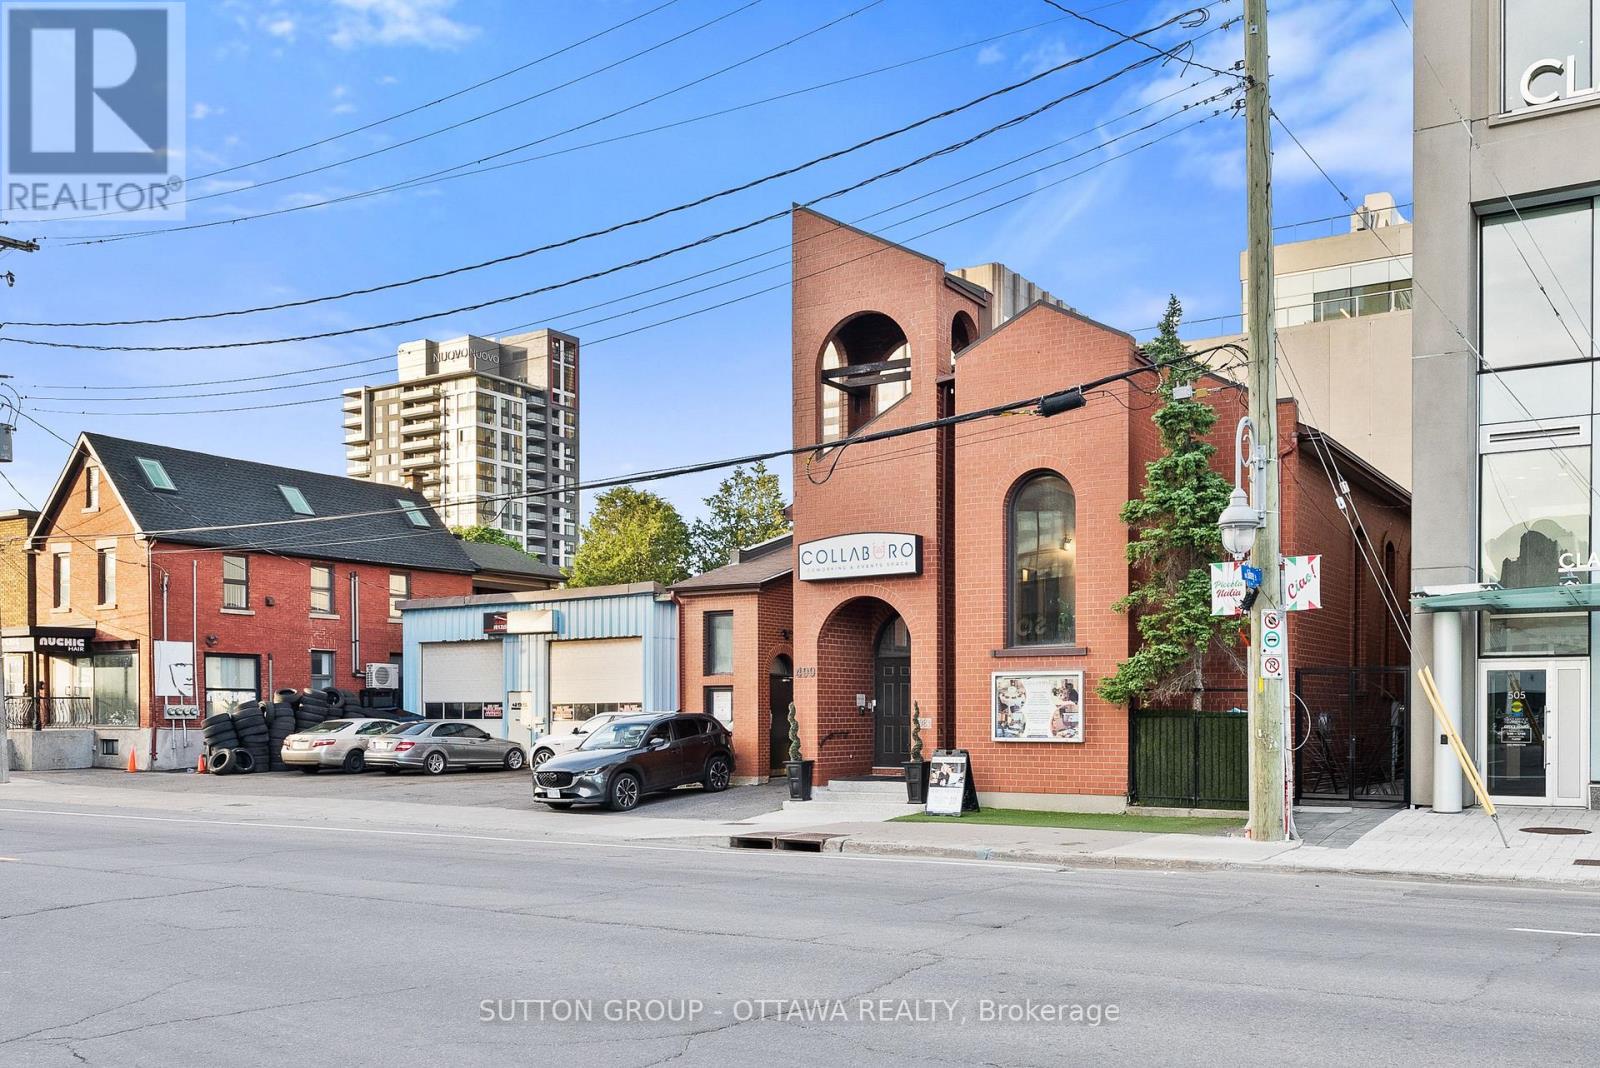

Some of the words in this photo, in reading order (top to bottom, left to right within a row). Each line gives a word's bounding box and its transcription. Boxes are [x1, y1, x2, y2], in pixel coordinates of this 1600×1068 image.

[1520, 54, 1600, 105] CL
[432, 347, 469, 363] NUOVO
[469, 347, 500, 364] NUOVO
[1507, 690, 1526, 700] 505
